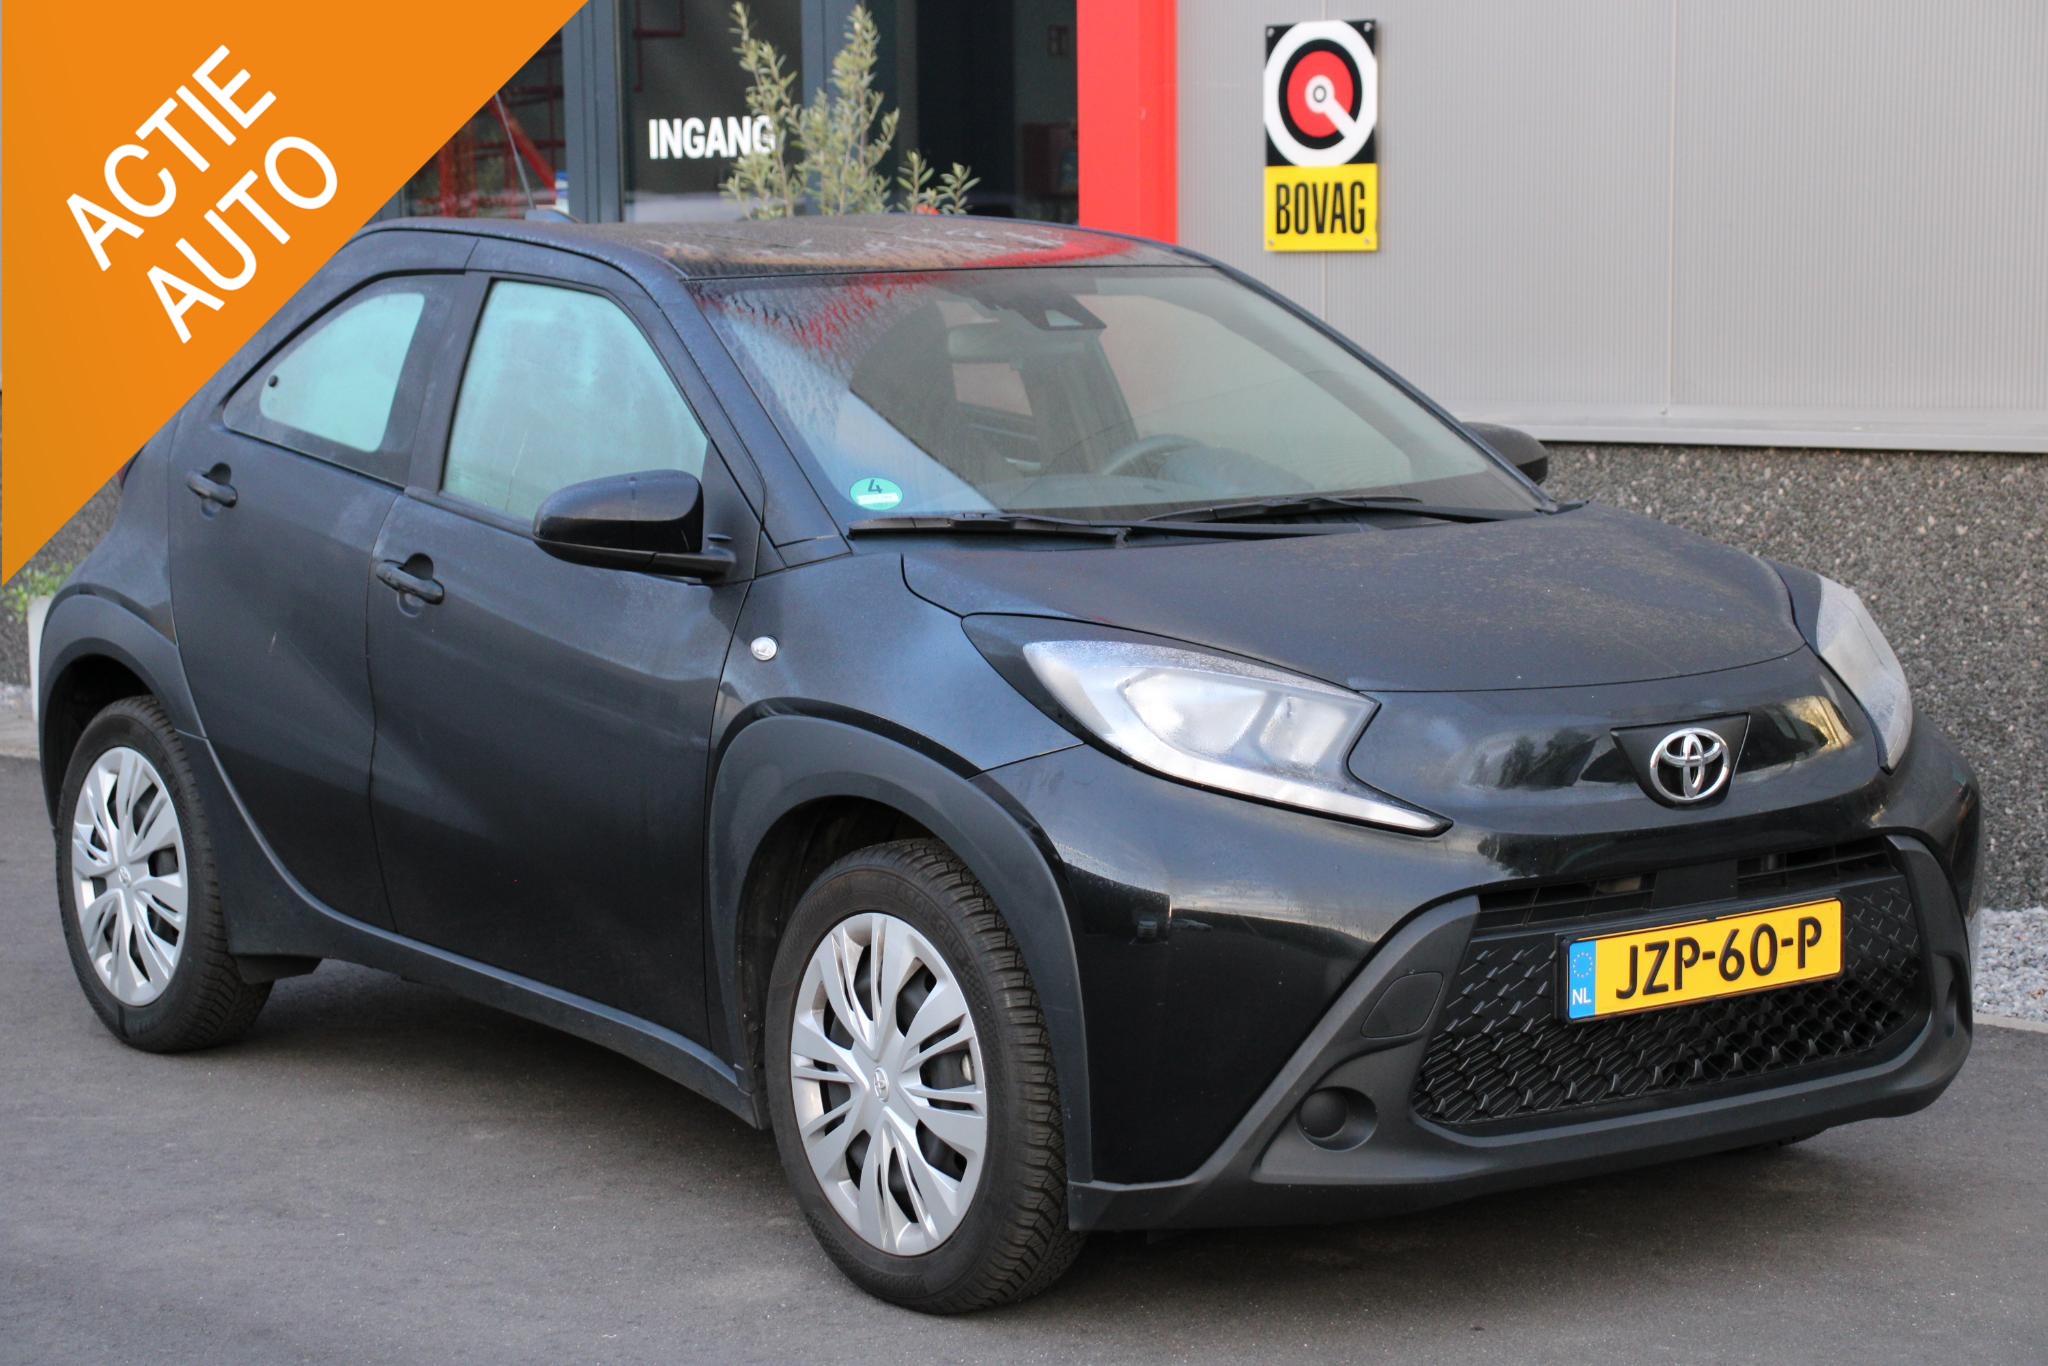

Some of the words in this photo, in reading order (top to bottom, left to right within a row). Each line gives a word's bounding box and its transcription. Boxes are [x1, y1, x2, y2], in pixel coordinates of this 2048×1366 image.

[648, 114, 776, 160] INGANG
[1275, 180, 1365, 235] BOVAG
[867, 479, 883, 494] 4
[1615, 915, 1823, 1000] JZP-60-P
[1572, 986, 1592, 1006] NL
